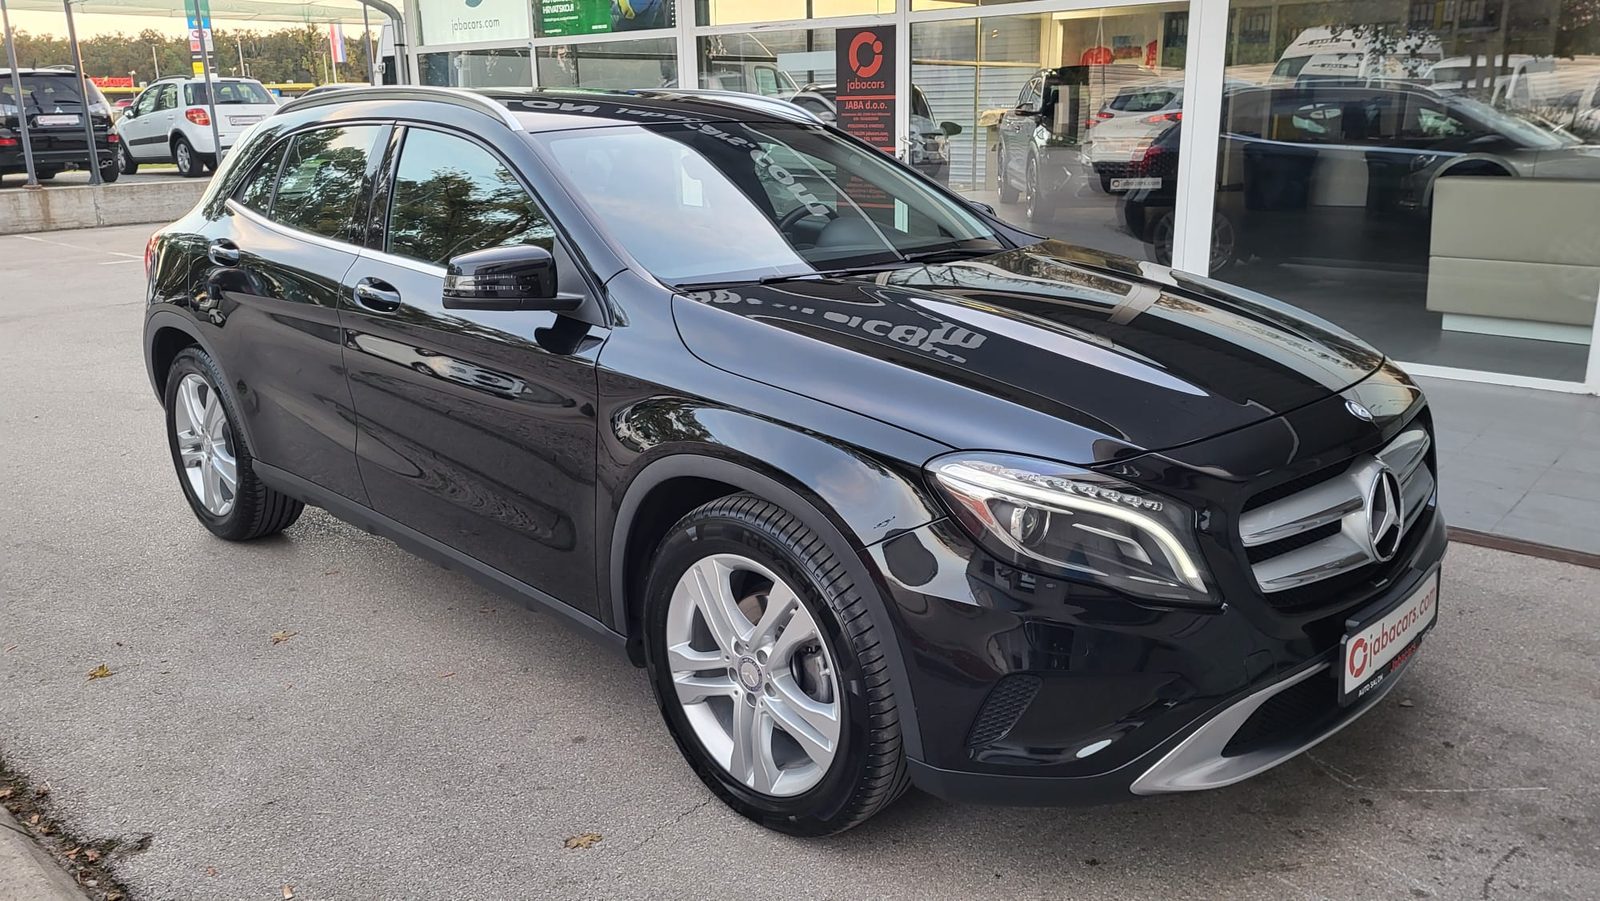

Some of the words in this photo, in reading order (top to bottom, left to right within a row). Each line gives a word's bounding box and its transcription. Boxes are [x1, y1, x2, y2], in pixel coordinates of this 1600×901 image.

[451, 17, 500, 35] jabacars.com
[846, 78, 885, 93] jabacars
[845, 101, 864, 110] JABA
[865, 100, 888, 109] d.o.o.
[1369, 587, 1436, 668] jabacars.com
[1359, 684, 1370, 697] AUTO
[1370, 673, 1383, 688] SALON
